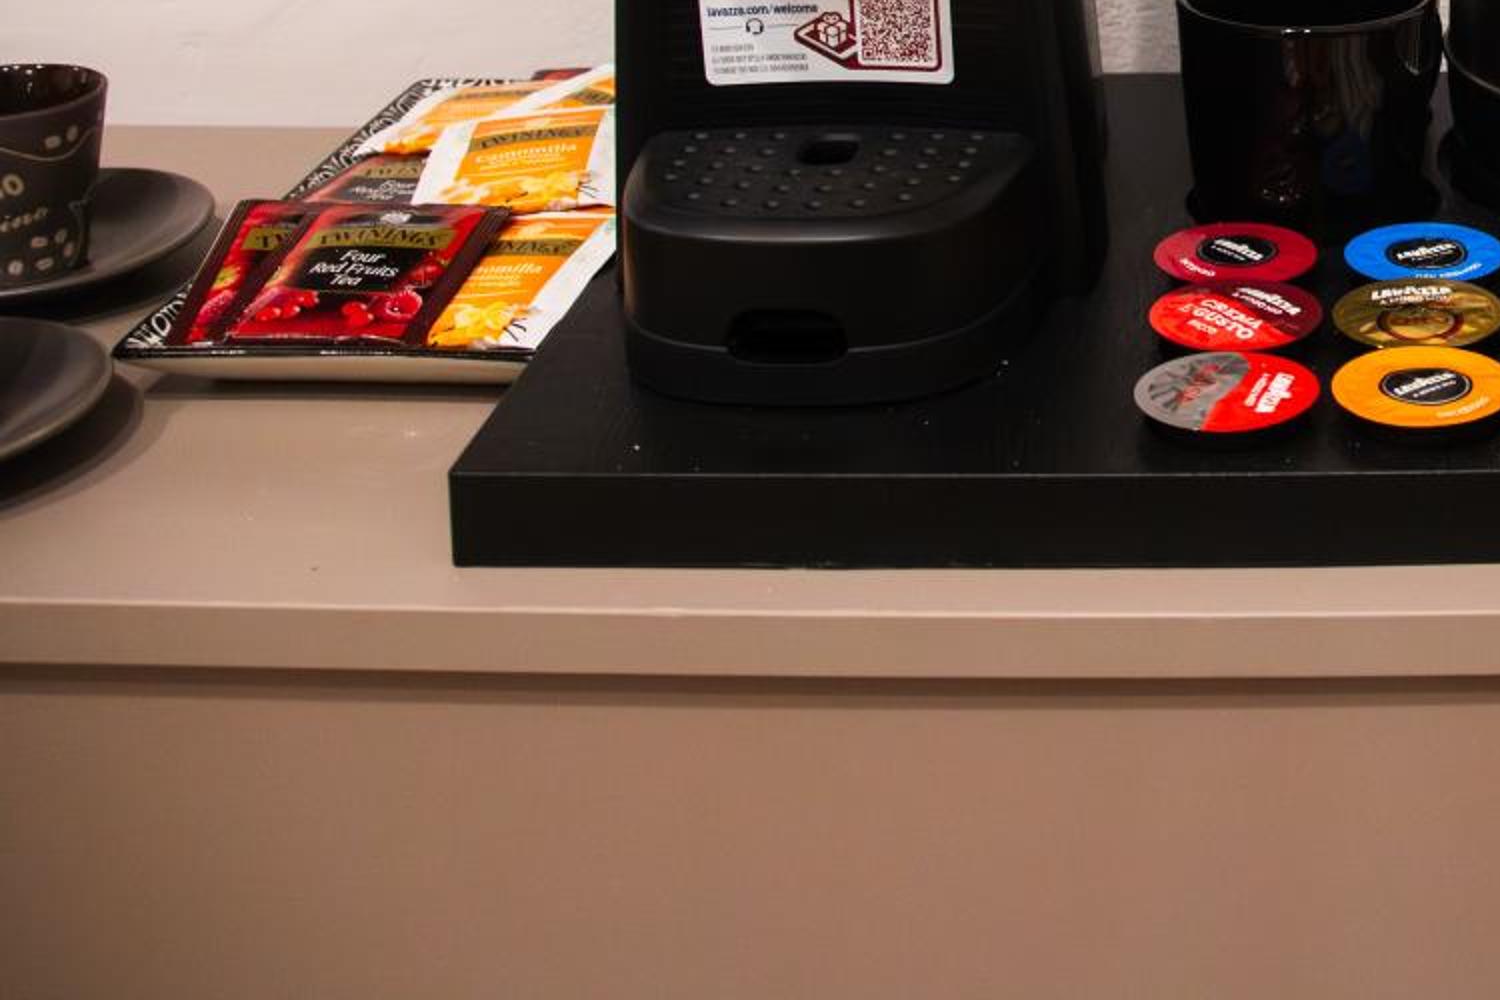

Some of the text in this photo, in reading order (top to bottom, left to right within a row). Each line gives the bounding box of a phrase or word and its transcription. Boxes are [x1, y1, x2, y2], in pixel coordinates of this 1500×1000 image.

[706, 2, 818, 17] lavazza.com/welcome
[318, 226, 443, 247] TWININGS
[340, 249, 387, 263] Four
[309, 260, 399, 278] Red Fruits
[330, 274, 363, 286] Tea
[1371, 285, 1454, 301] LAVAZZA
[1193, 304, 1256, 340] GUSTO
[1201, 299, 1264, 330] CREMA
